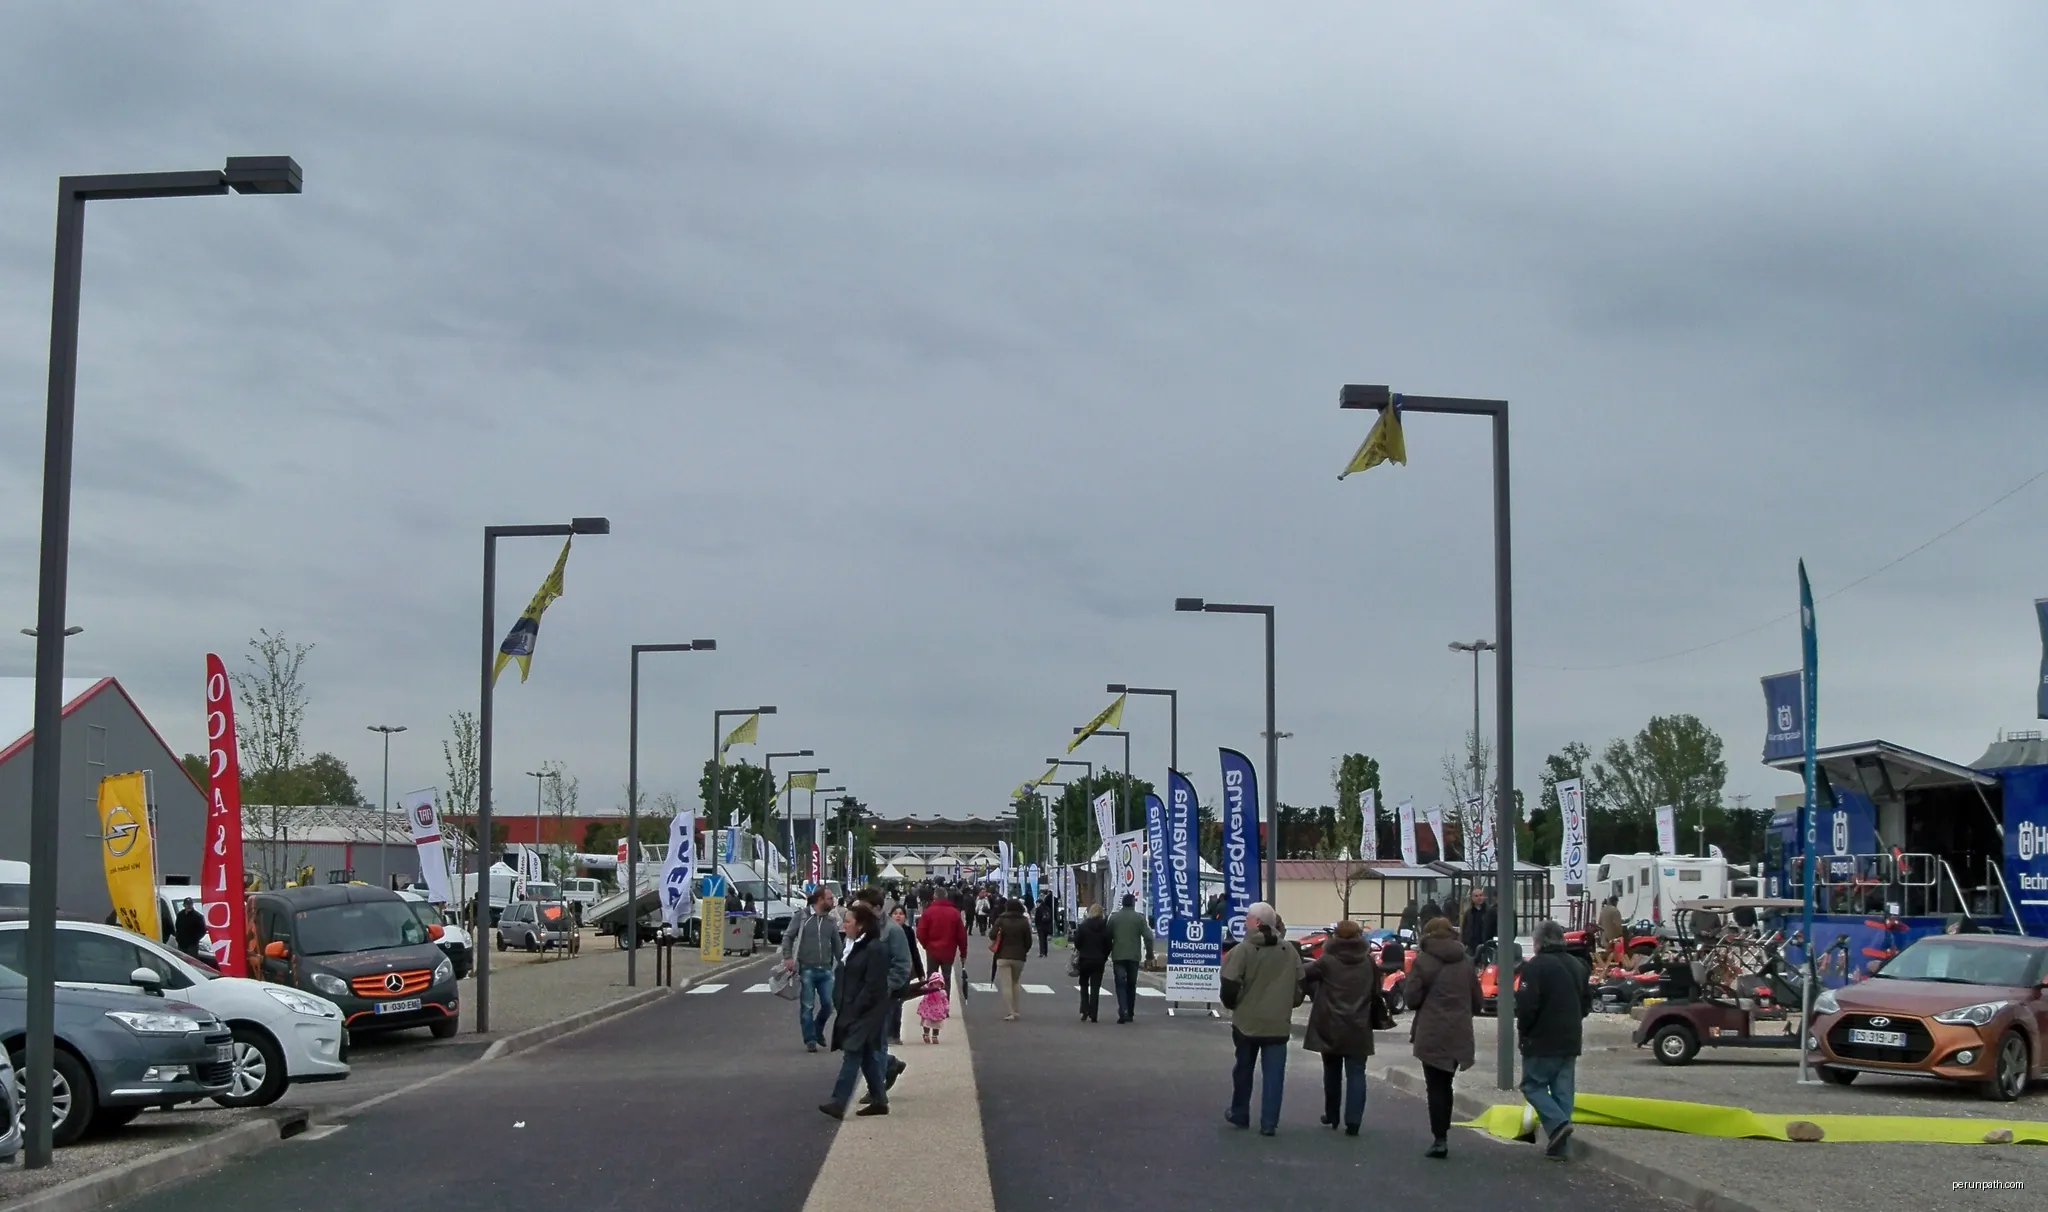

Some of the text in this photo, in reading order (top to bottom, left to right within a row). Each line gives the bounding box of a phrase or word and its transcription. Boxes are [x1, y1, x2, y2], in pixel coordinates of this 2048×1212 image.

[713, 900, 721, 948] VAUCLUSE
[1171, 940, 1219, 951] Husqvarna
[1175, 973, 1213, 981] JARDINAGE
